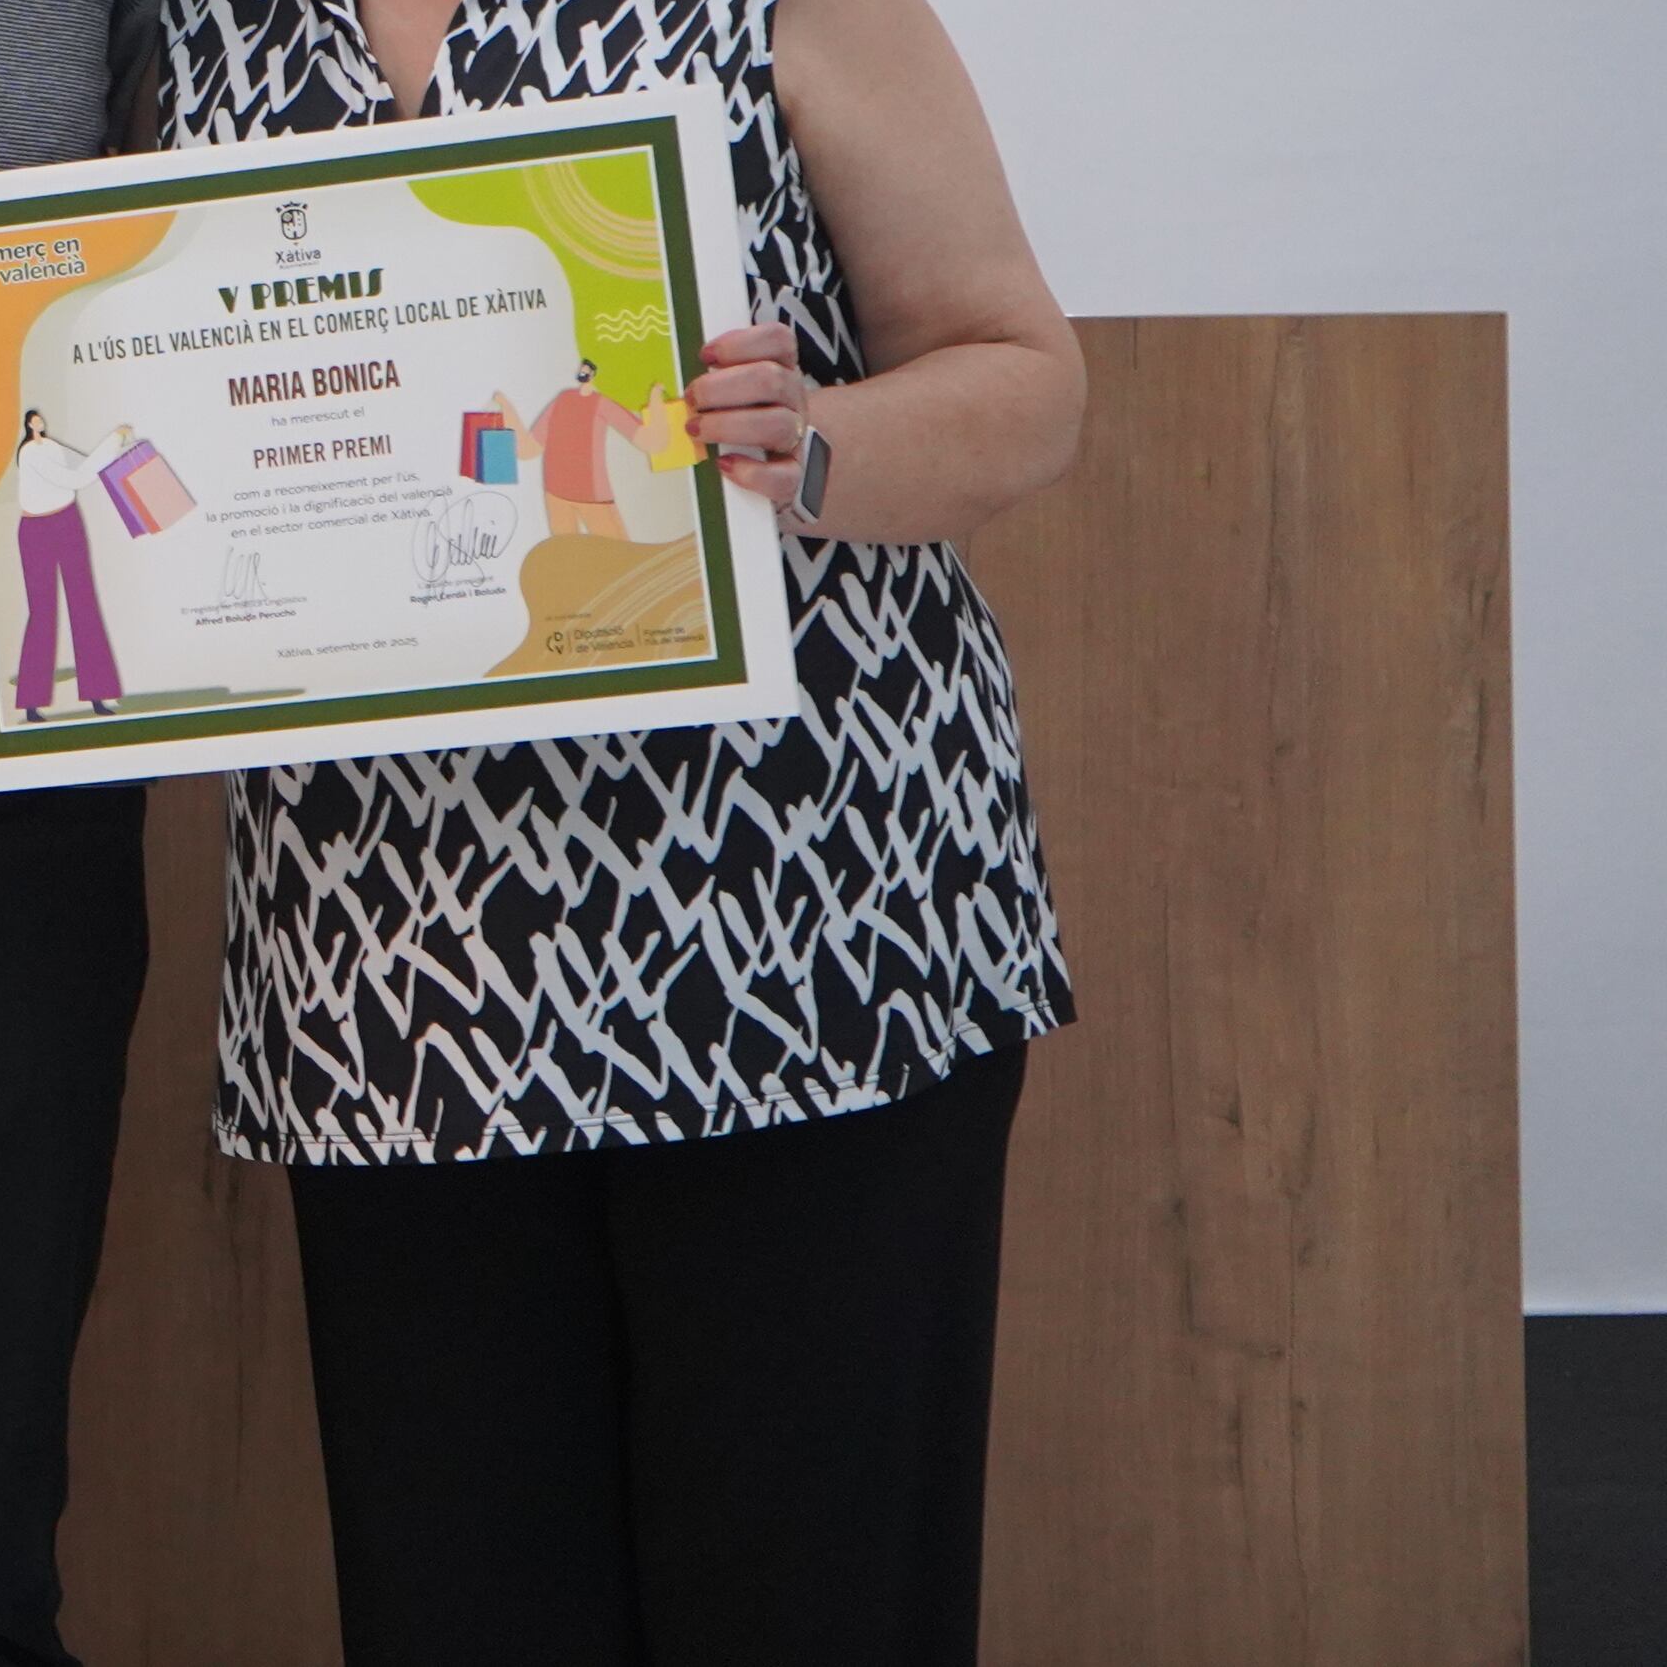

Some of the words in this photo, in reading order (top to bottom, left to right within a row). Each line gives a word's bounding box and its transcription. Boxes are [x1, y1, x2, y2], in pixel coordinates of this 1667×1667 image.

[54, 239, 79, 253] en
[276, 249, 321, 264] Xàtiva
[0, 255, 85, 283] valencià
[218, 286, 238, 313] V
[251, 268, 384, 310] PREMIS
[74, 345, 83, 364] A
[90, 336, 126, 361] L'ÚS
[133, 336, 165, 357] DEL
[170, 319, 254, 352] VALENCIÀ
[260, 320, 281, 342] EN
[289, 318, 308, 338] EL
[315, 308, 388, 334] COMERÇ
[396, 300, 451, 325] LOCAL
[457, 296, 479, 318] DE
[485, 288, 547, 315] XÀTIVA
[229, 371, 306, 406] MARIA
[312, 360, 401, 397] BONICA
[272, 417, 287, 427] ha
[291, 410, 349, 425] merescut
[354, 407, 365, 417] el
[254, 443, 326, 469] PRIMER
[333, 434, 392, 460] PREMI
[234, 491, 260, 501] com
[276, 478, 368, 496] reconeixement
[373, 476, 393, 487] per
[207, 512, 217, 522] la
[221, 507, 279, 523] promoció
[282, 506, 286, 514] i
[290, 503, 300, 513] la
[305, 496, 375, 514] dignificació
[379, 492, 397, 503] del
[402, 487, 453, 500] valencià
[231, 529, 247, 538] en
[251, 525, 262, 536] el
[265, 523, 303, 535] sector
[308, 517, 368, 530] comercial
[372, 513, 388, 523] de
[317, 641, 370, 655] setembre
[374, 639, 387, 648] de
[391, 638, 418, 647] 2025
